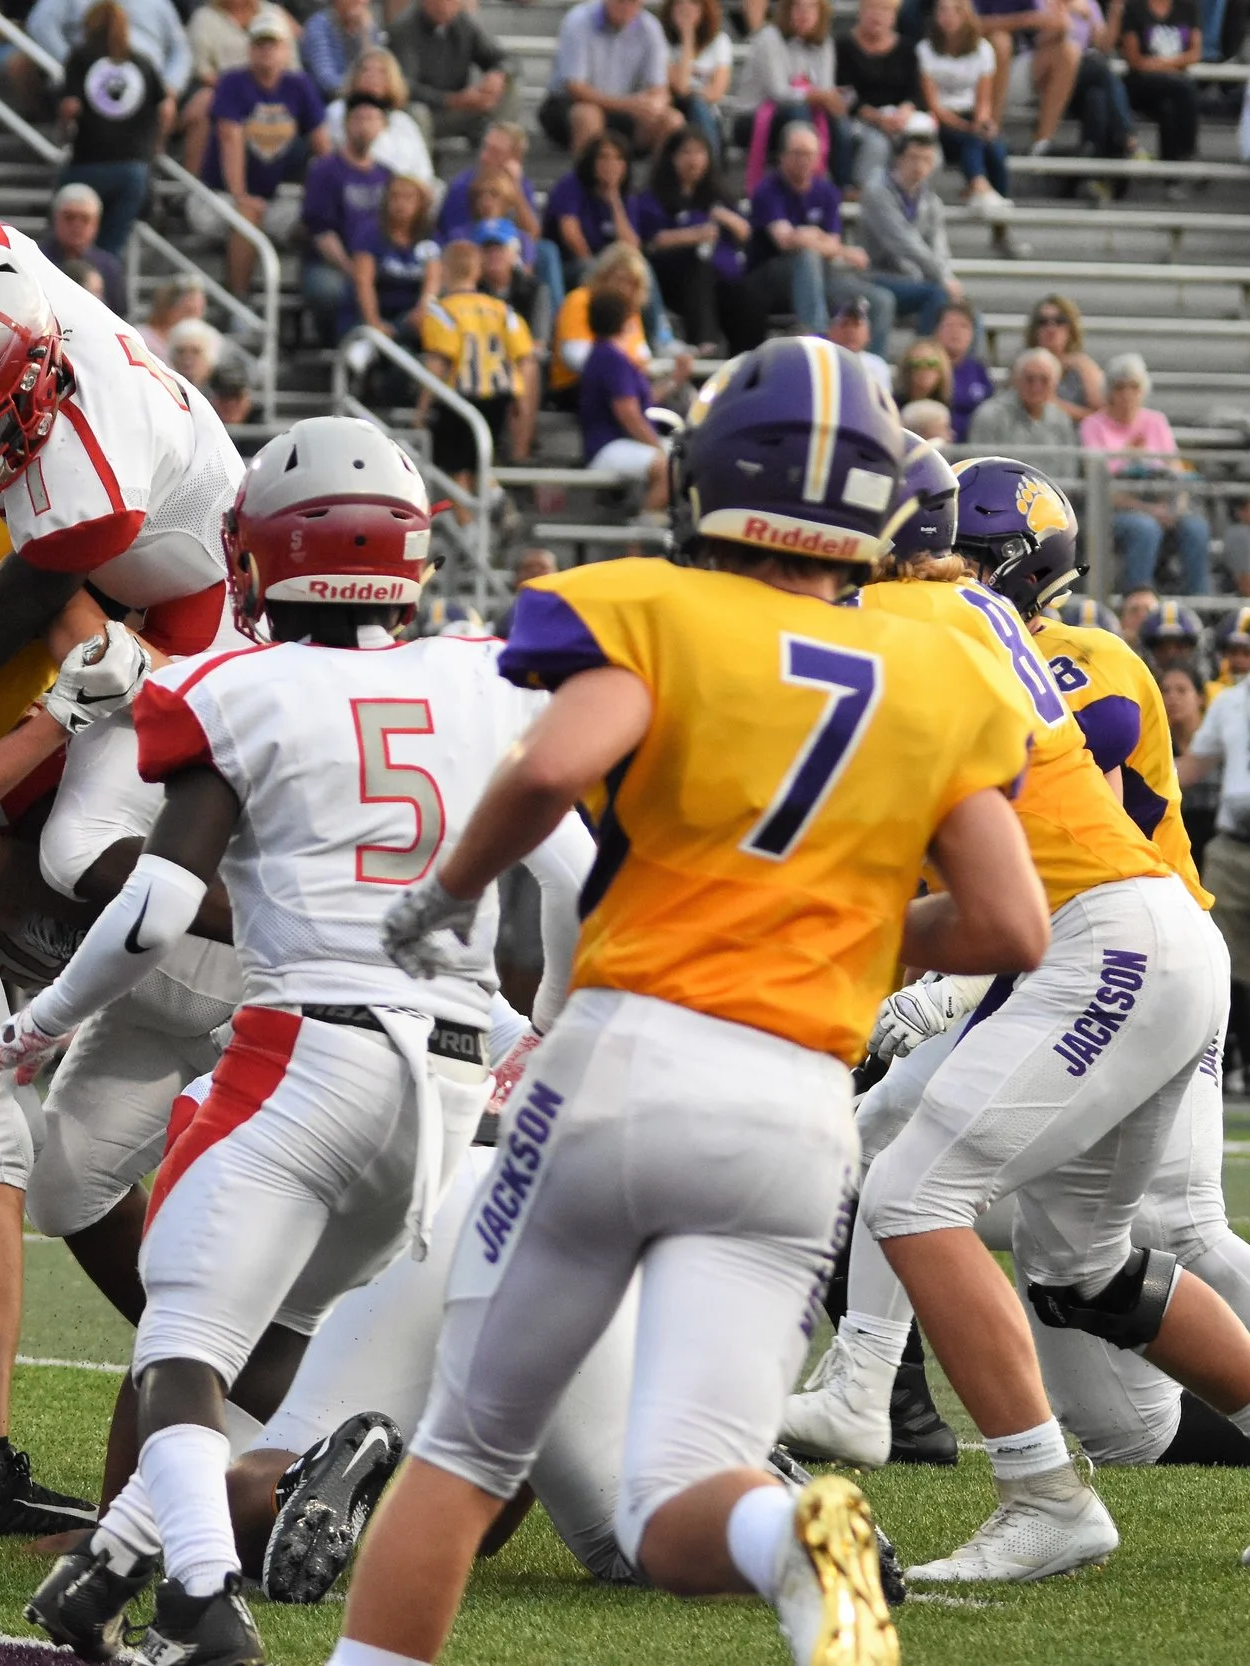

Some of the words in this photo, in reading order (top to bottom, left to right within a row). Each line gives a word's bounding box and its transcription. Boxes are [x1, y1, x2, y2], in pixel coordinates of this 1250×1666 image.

[309, 580, 404, 600] Riddell
[742, 516, 861, 558] Riddell
[954, 578, 1068, 729] 8
[349, 697, 446, 886] 5
[737, 630, 884, 862] 7
[1052, 949, 1148, 1077] JACKSON
[475, 1079, 566, 1265] JACKSON
